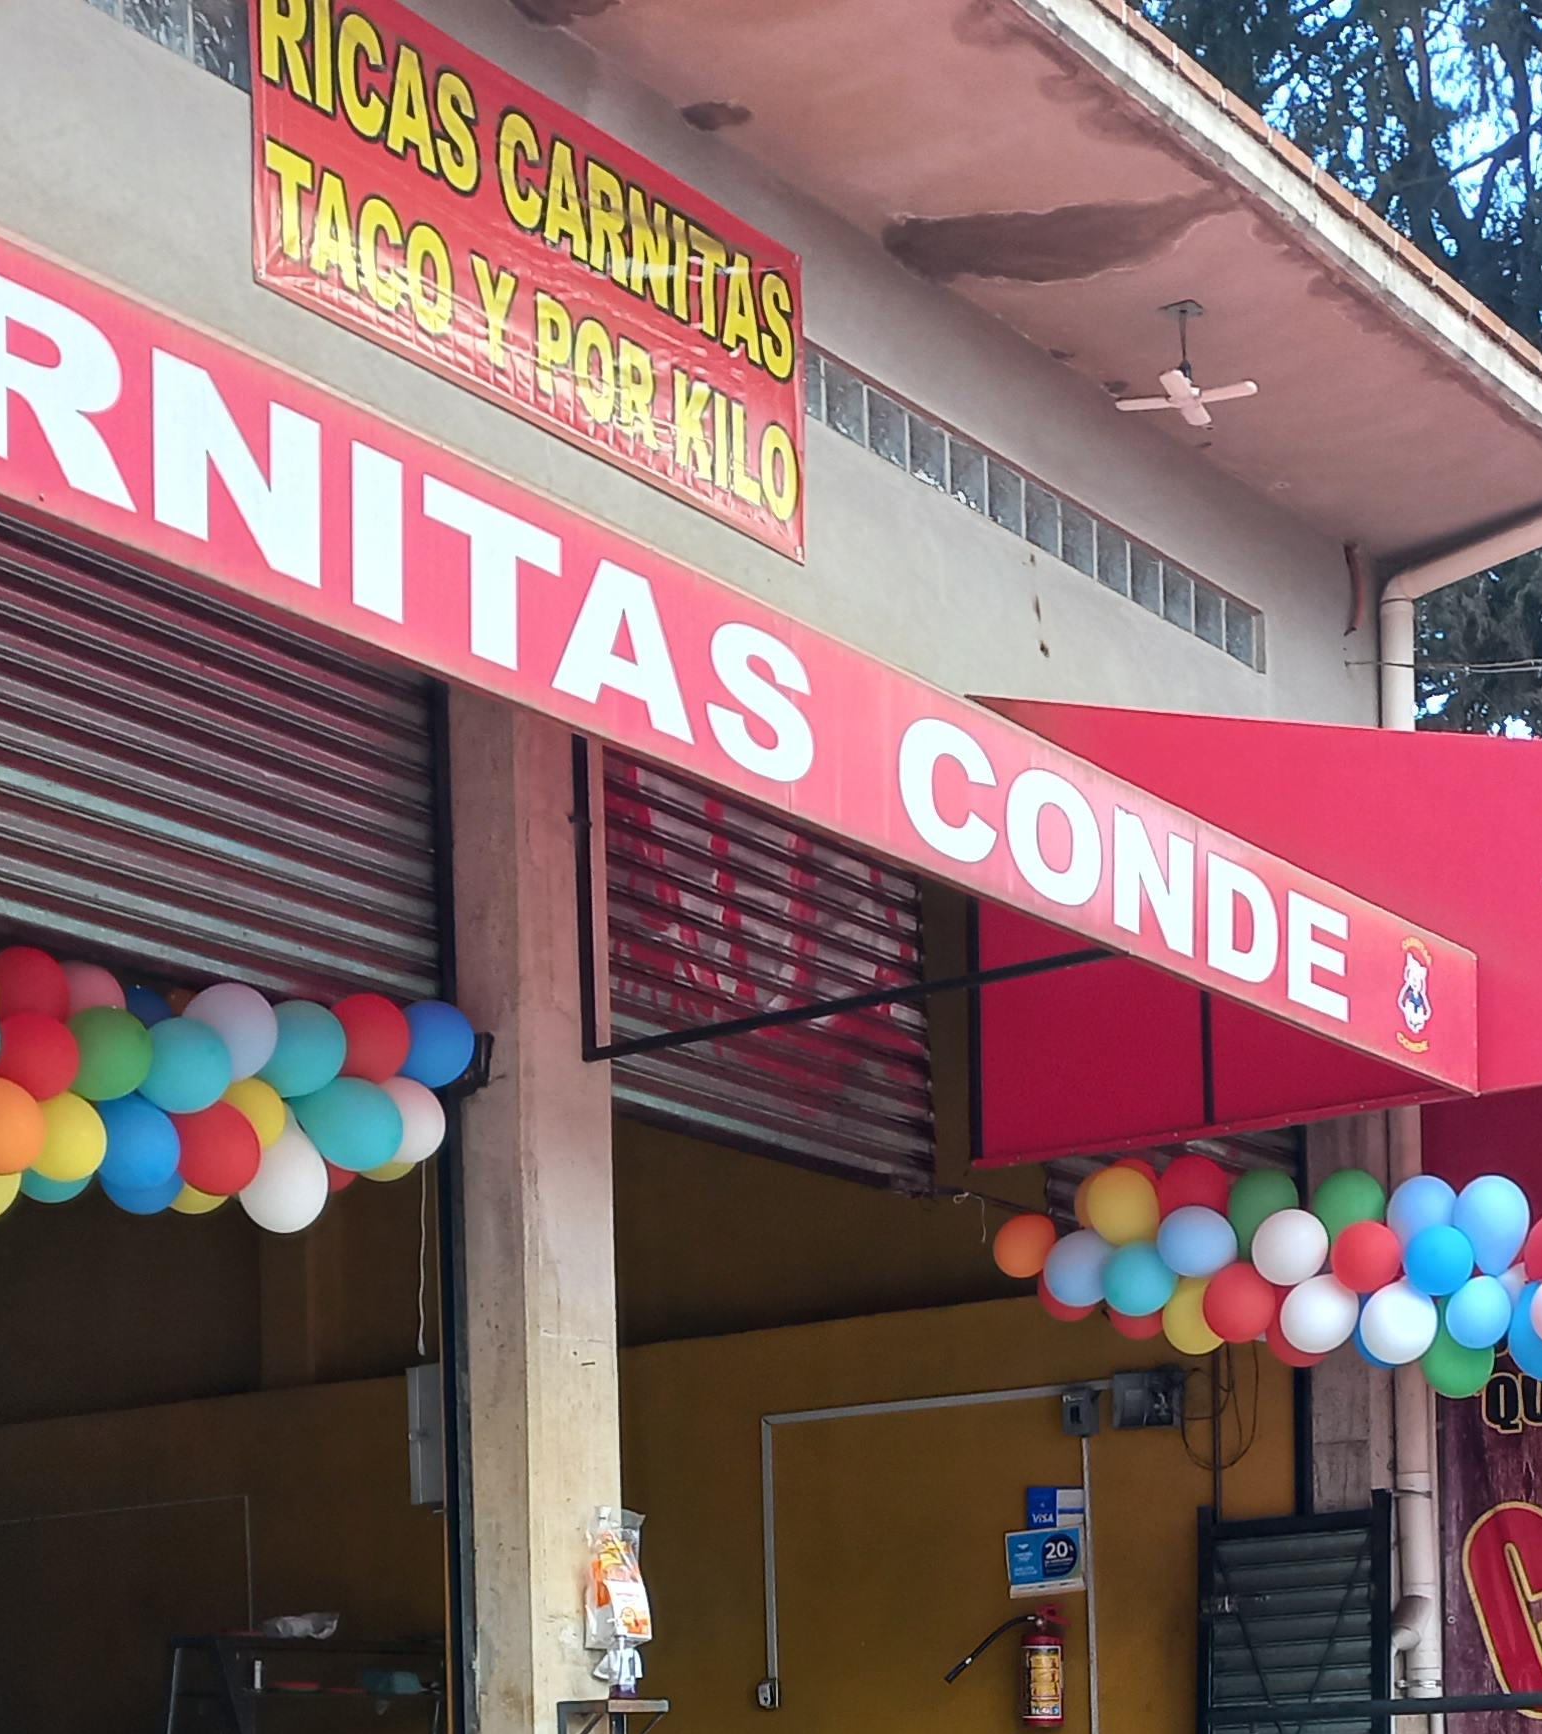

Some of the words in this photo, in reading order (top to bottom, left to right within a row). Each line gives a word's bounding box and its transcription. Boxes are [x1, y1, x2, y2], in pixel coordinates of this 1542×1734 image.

[258, 0, 480, 196] RICAS
[496, 109, 796, 382] CARNITAS
[264, 137, 452, 337] TACO
[469, 252, 518, 370] Y
[533, 290, 659, 452] POR
[672, 366, 801, 523] KILO
[897, 717, 1351, 1023] CONDE
[1031, 1513, 1055, 1524] VISA
